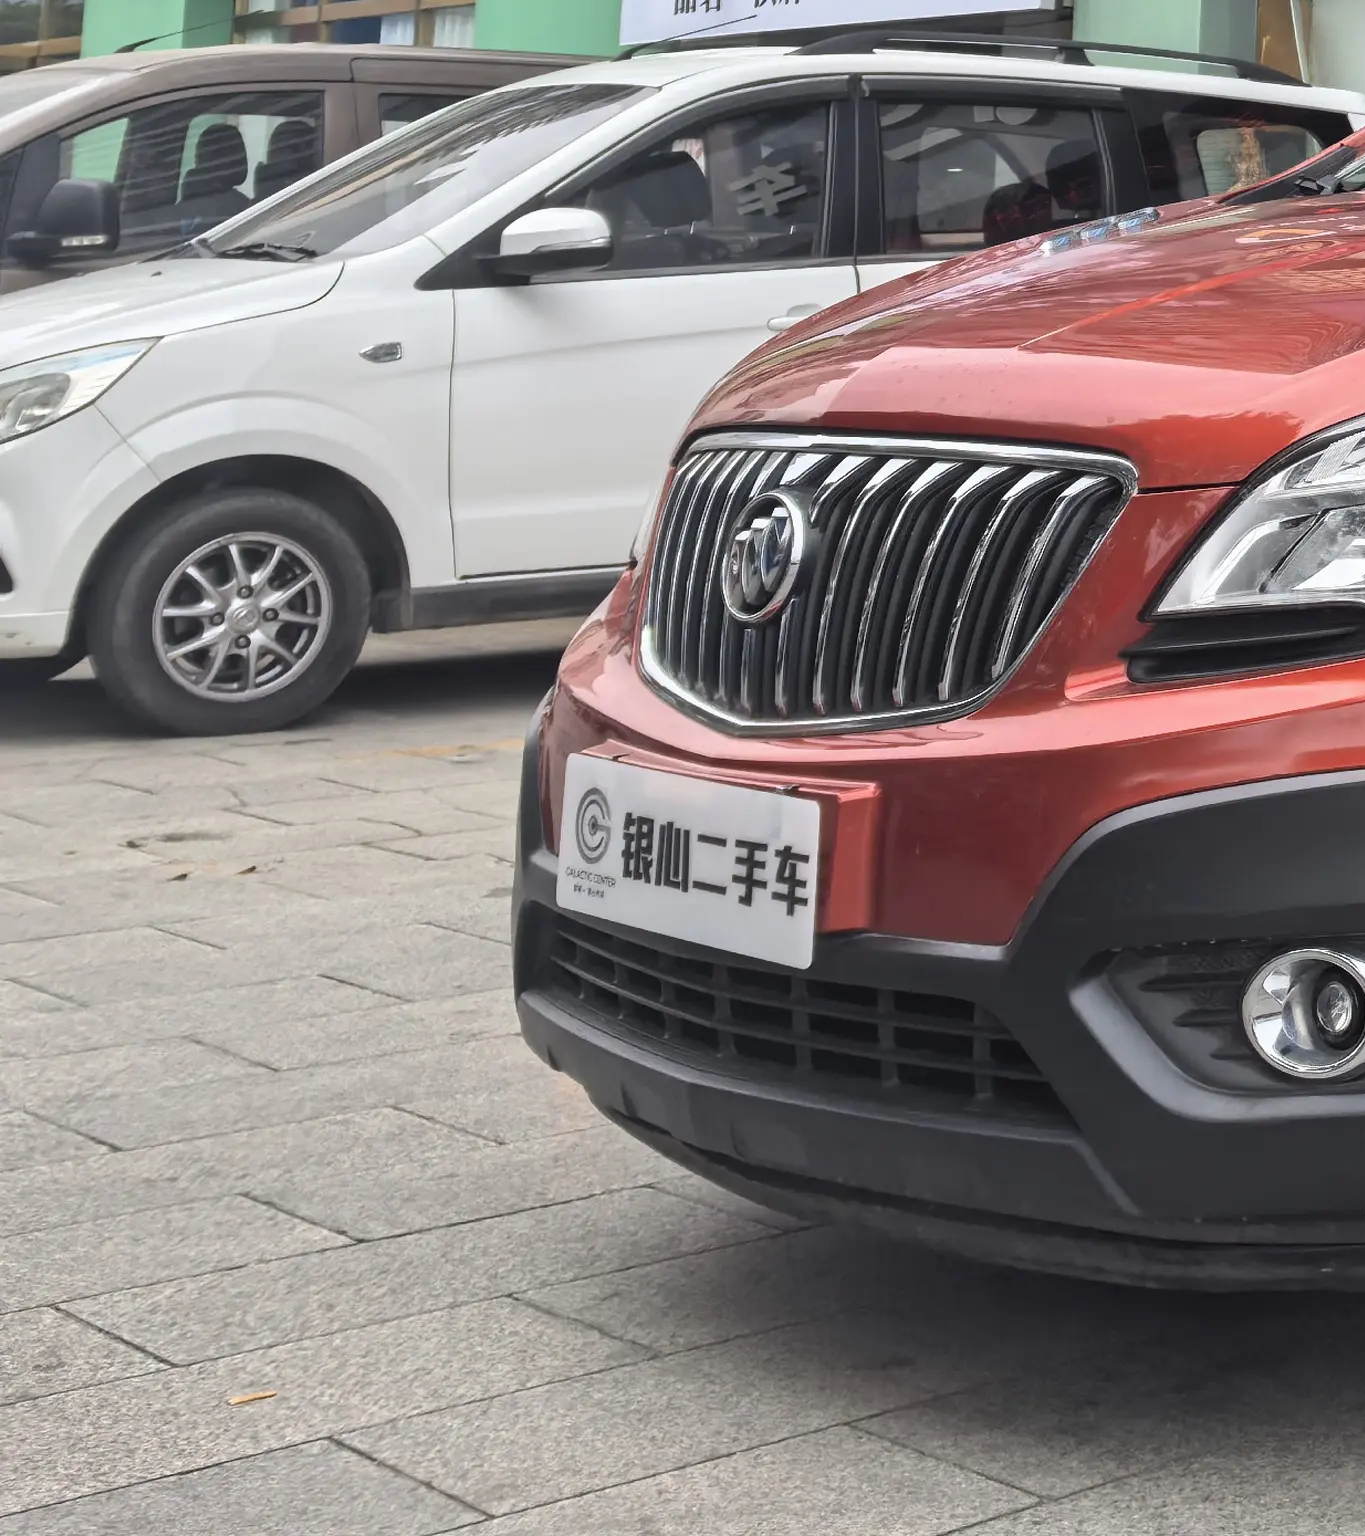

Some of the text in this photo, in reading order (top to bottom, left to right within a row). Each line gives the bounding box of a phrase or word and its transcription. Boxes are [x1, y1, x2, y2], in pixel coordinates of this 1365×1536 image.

[622, 812, 810, 917] 银心二手车
